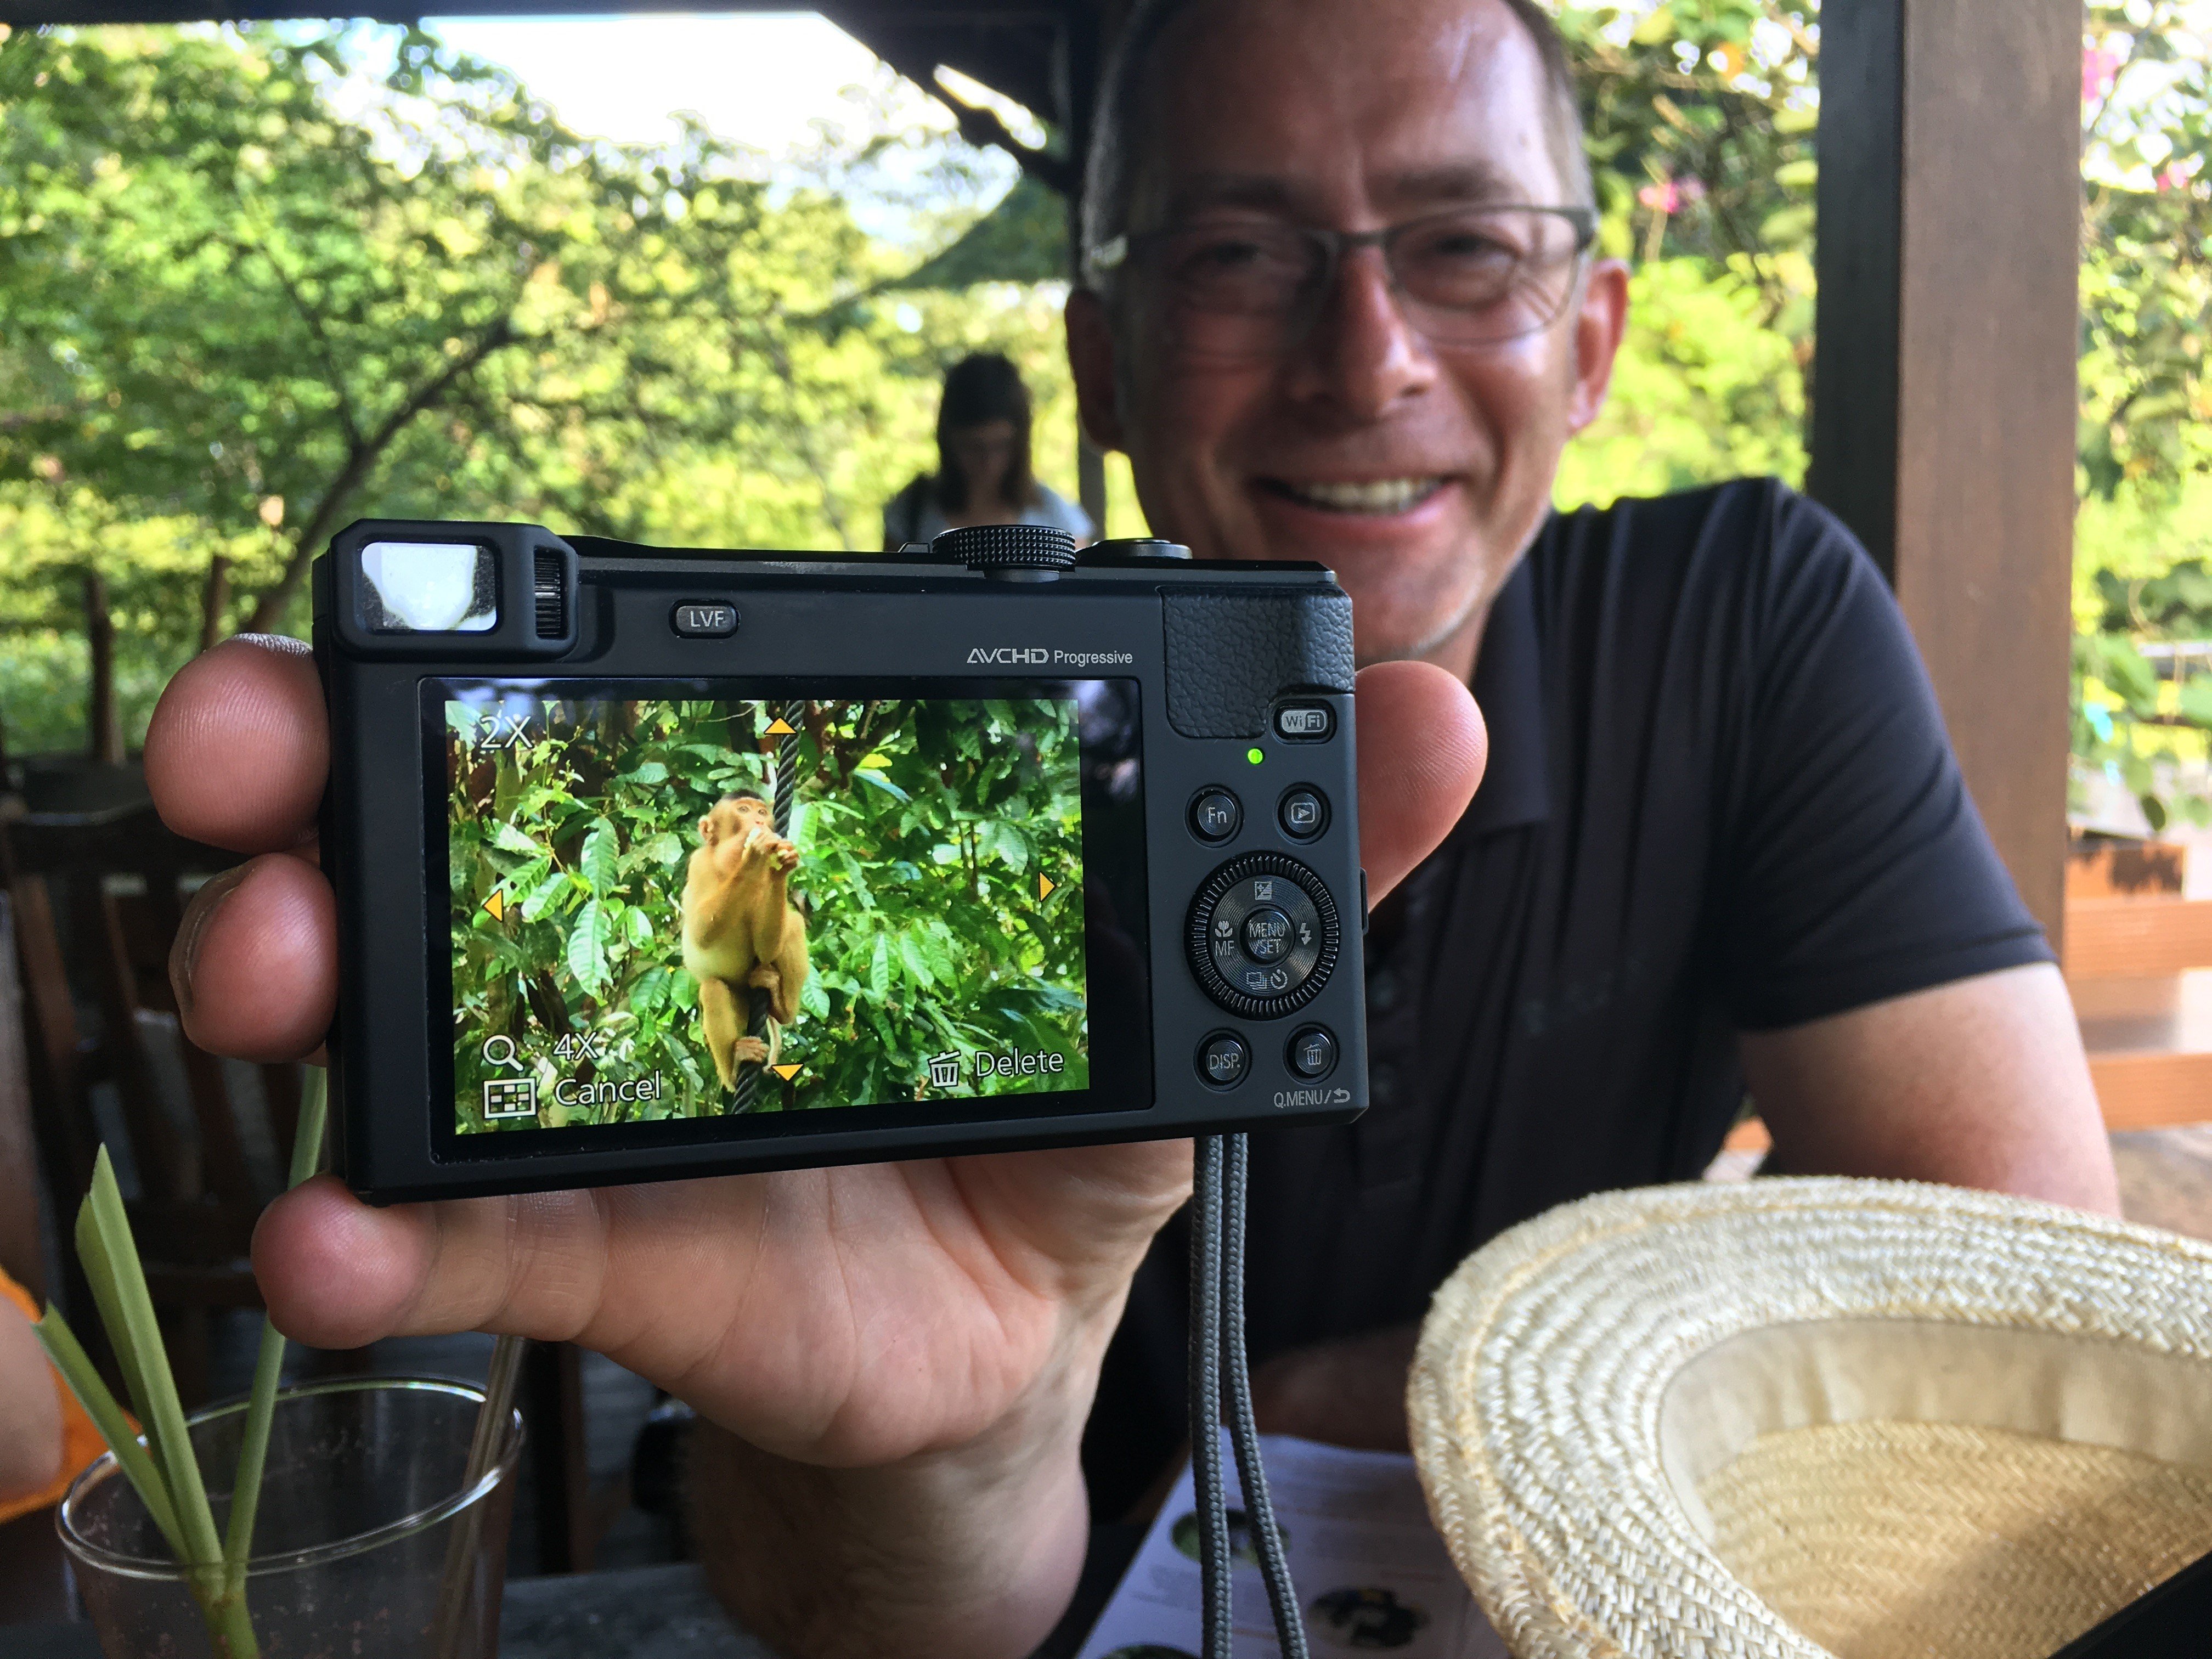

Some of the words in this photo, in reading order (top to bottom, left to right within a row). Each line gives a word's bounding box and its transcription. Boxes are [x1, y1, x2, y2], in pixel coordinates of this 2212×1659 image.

[690, 611, 725, 627] LVF
[966, 648, 1049, 664] AVCHD
[1054, 650, 1133, 667] Progressive
[480, 715, 533, 748] 2X
[1207, 807, 1227, 823] Fn
[1249, 923, 1285, 937] MENU
[1215, 940, 1234, 956] MF
[554, 1032, 599, 1060] 4X
[975, 1048, 1064, 1077] Delete
[555, 1070, 661, 1106] Cancel
